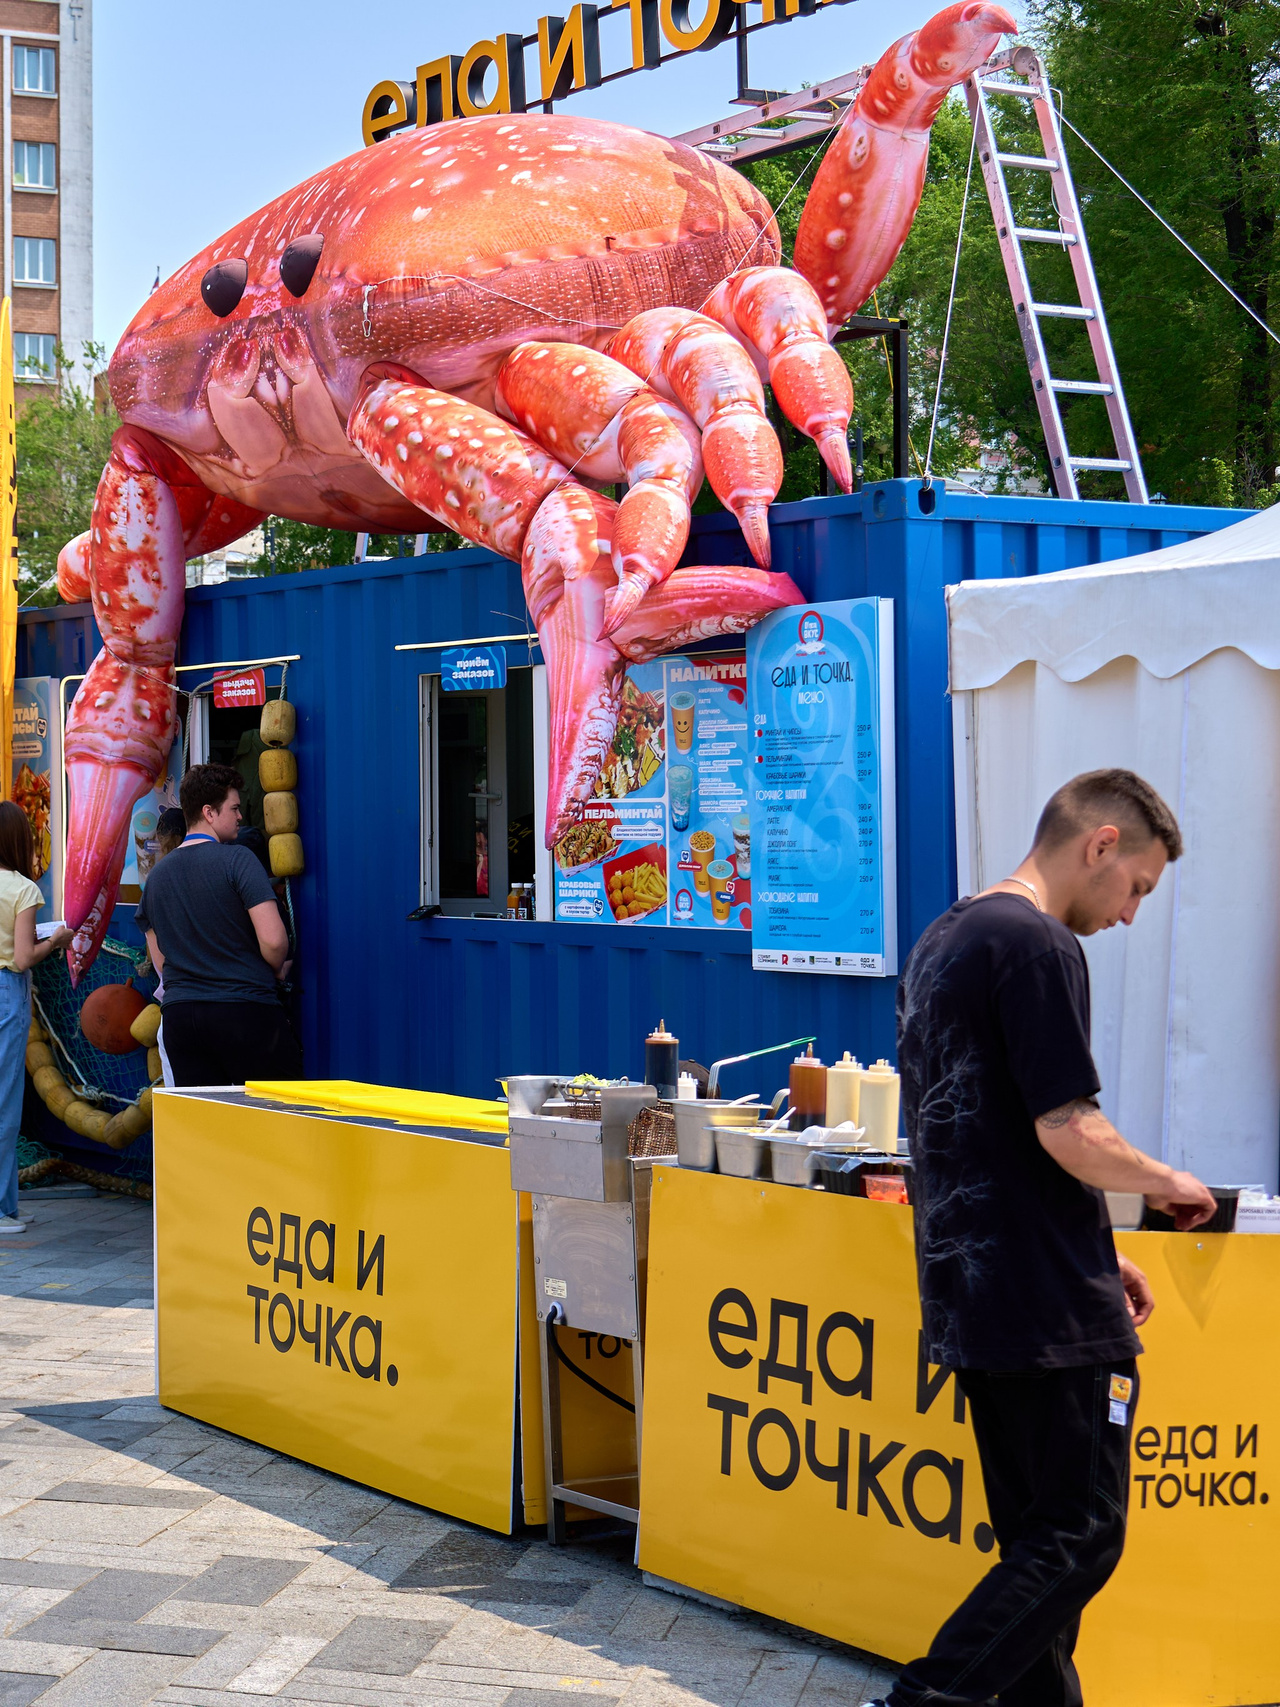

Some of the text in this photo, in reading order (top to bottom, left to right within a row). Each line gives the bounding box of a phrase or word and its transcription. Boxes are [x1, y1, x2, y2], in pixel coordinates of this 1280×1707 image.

[536, 3, 601, 101] и
[452, 670, 494, 679] заказов
[456, 656, 490, 670] приём
[802, 665, 808, 685] И
[222, 679, 254, 688] выдача
[222, 688, 256, 697] заказов
[584, 805, 662, 819] ПЕЛЬМИНТАЙ
[246, 1206, 386, 1296] еда и
[246, 1284, 399, 1387] точка.
[708, 1288, 874, 1406] еда
[1134, 1424, 1258, 1468] еда и
[707, 1392, 995, 1554] точка.
[1133, 1470, 1269, 1509] точка.
